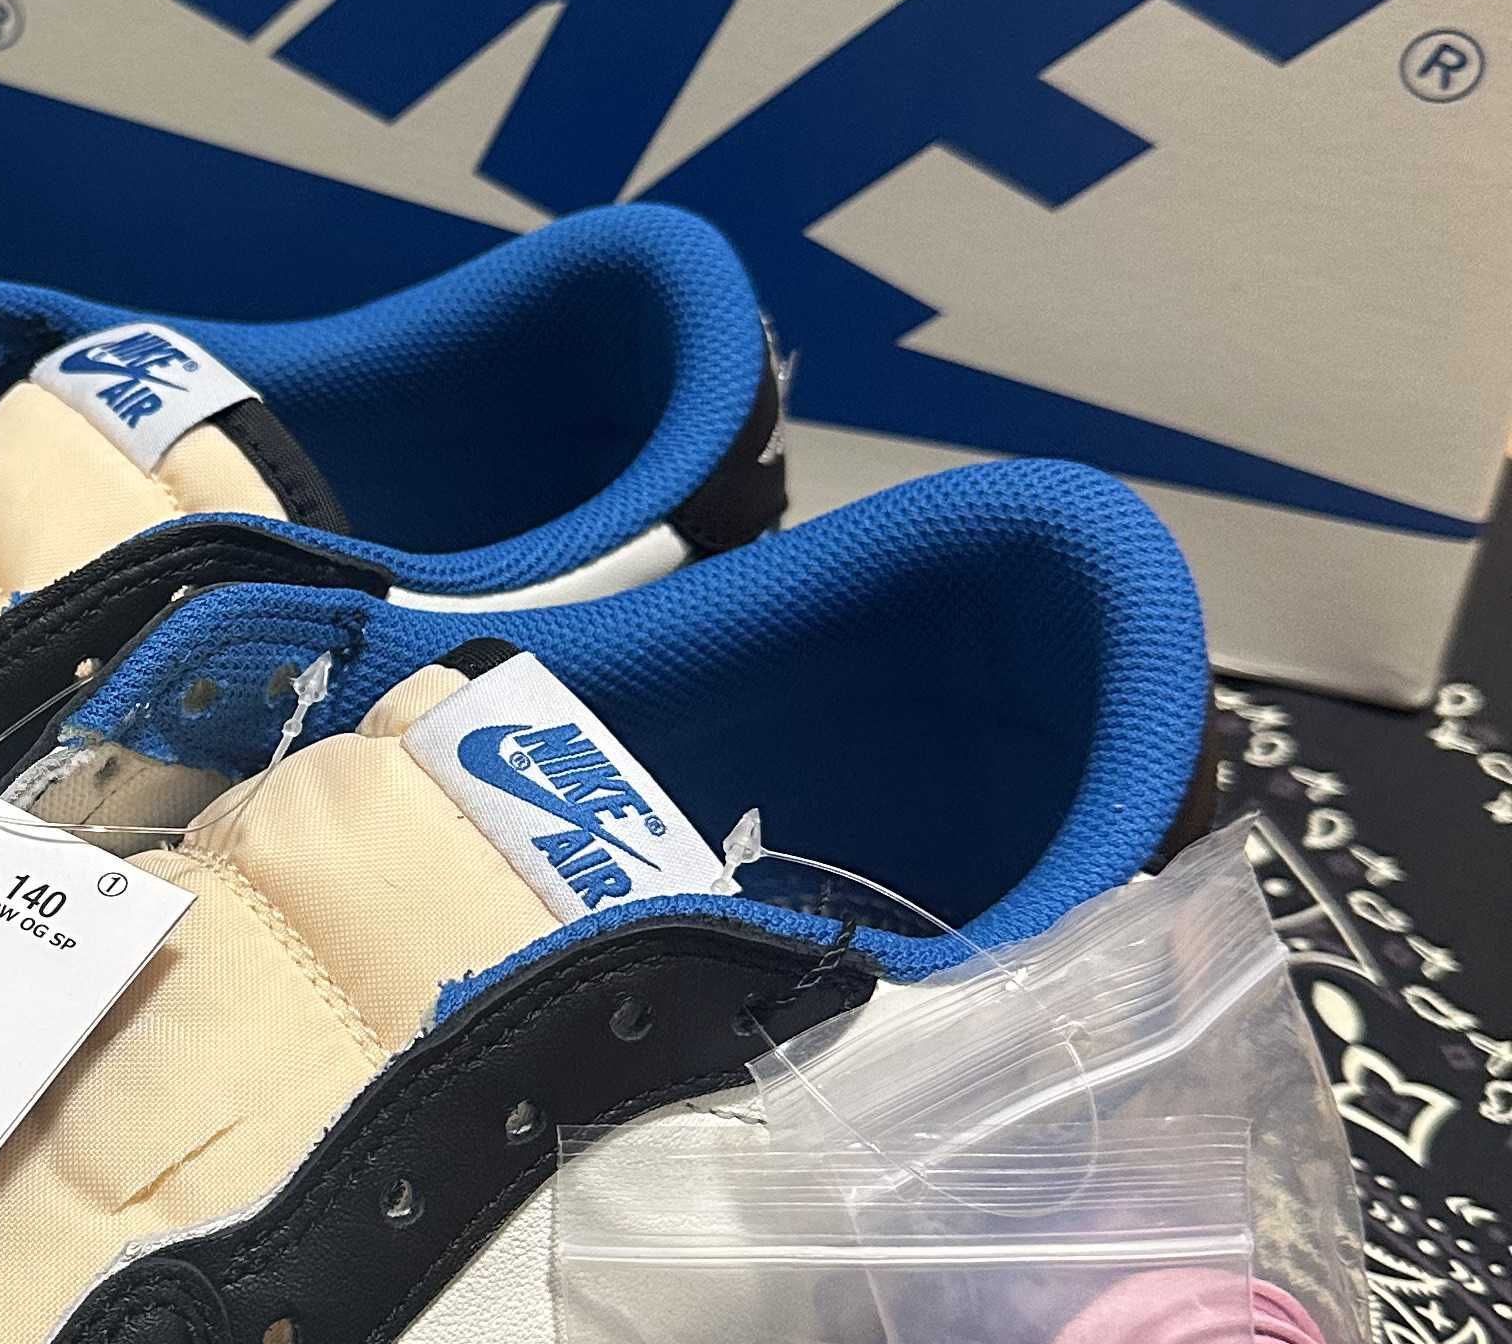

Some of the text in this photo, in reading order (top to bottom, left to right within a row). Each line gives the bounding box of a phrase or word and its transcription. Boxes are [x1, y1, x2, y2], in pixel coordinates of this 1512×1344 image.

[100, 332, 192, 374] NIKE
[96, 378, 163, 429] AIR
[513, 723, 653, 825] NIKE
[531, 829, 632, 909] AIR
[6, 874, 67, 918] 140
[20, 917, 50, 938] OG
[49, 932, 77, 951] SP
